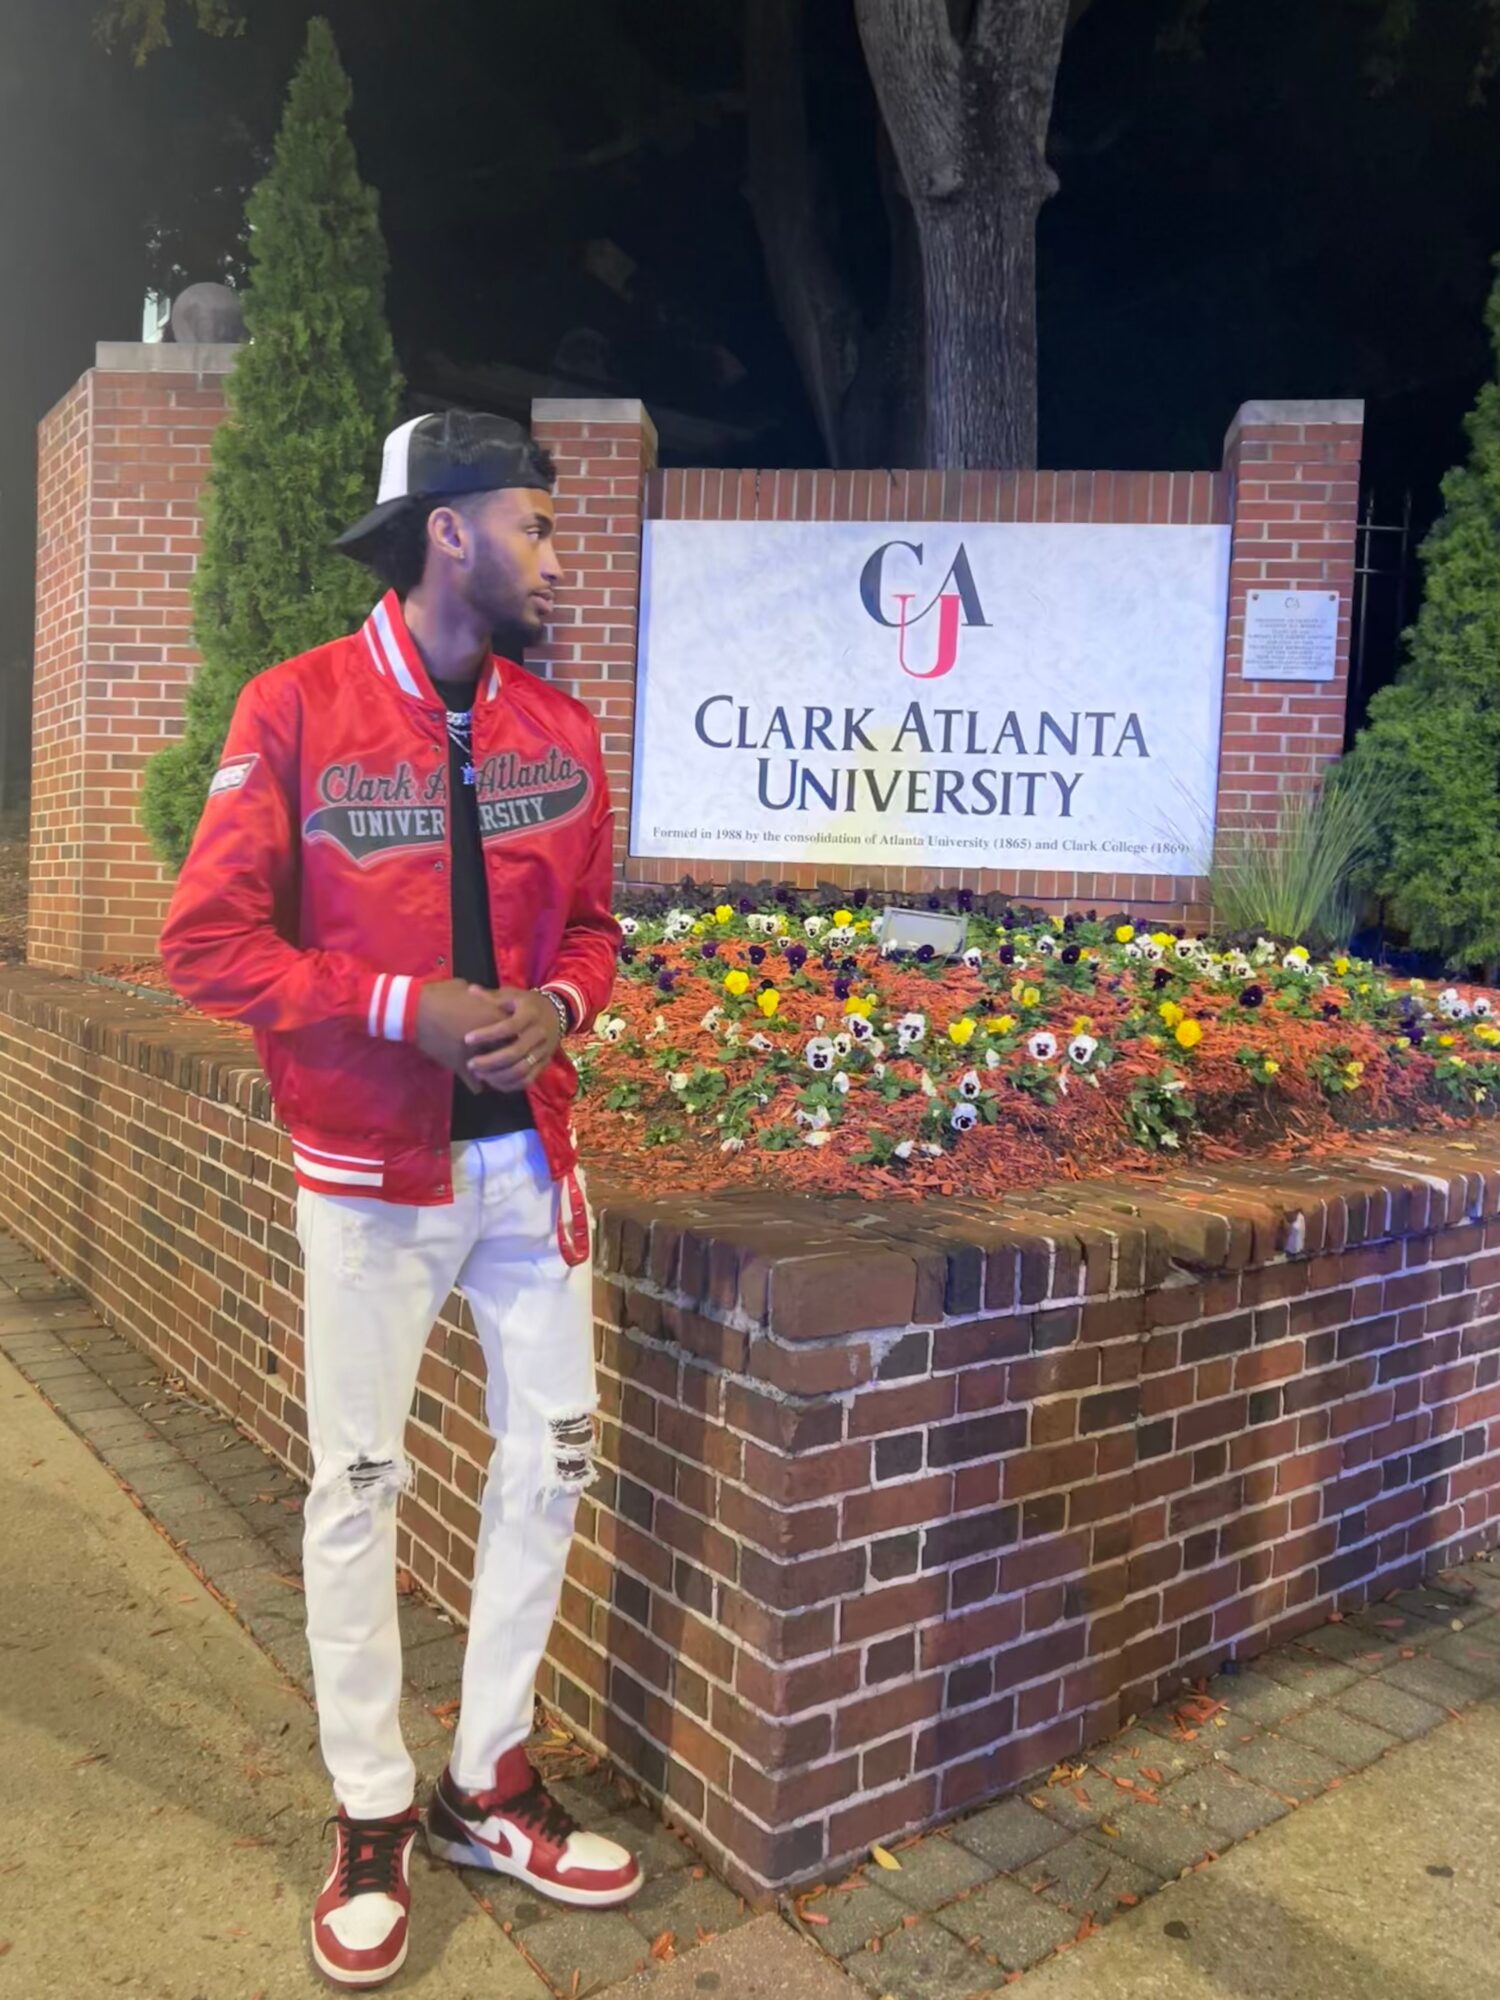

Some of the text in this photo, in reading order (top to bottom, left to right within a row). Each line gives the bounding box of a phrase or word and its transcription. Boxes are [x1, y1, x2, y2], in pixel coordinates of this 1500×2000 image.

[694, 694, 1151, 758] CLARK ATLANTA
[320, 762, 413, 803] Clark
[475, 747, 575, 793] Atlanta
[757, 757, 1085, 818] UNIVERSITY
[653, 826, 697, 839] Formed
[701, 828, 712, 839] in
[716, 829, 742, 840] 1988
[746, 830, 758, 843] by
[763, 831, 780, 842] the
[783, 832, 861, 845] consolidation
[864, 833, 877, 845] of
[880, 834, 924, 847] Atlanta
[928, 835, 990, 851] University
[993, 837, 1032, 850] (1865)
[1035, 838, 1058, 850] and
[1062, 838, 1097, 852] Clark
[1101, 840, 1148, 855] College
